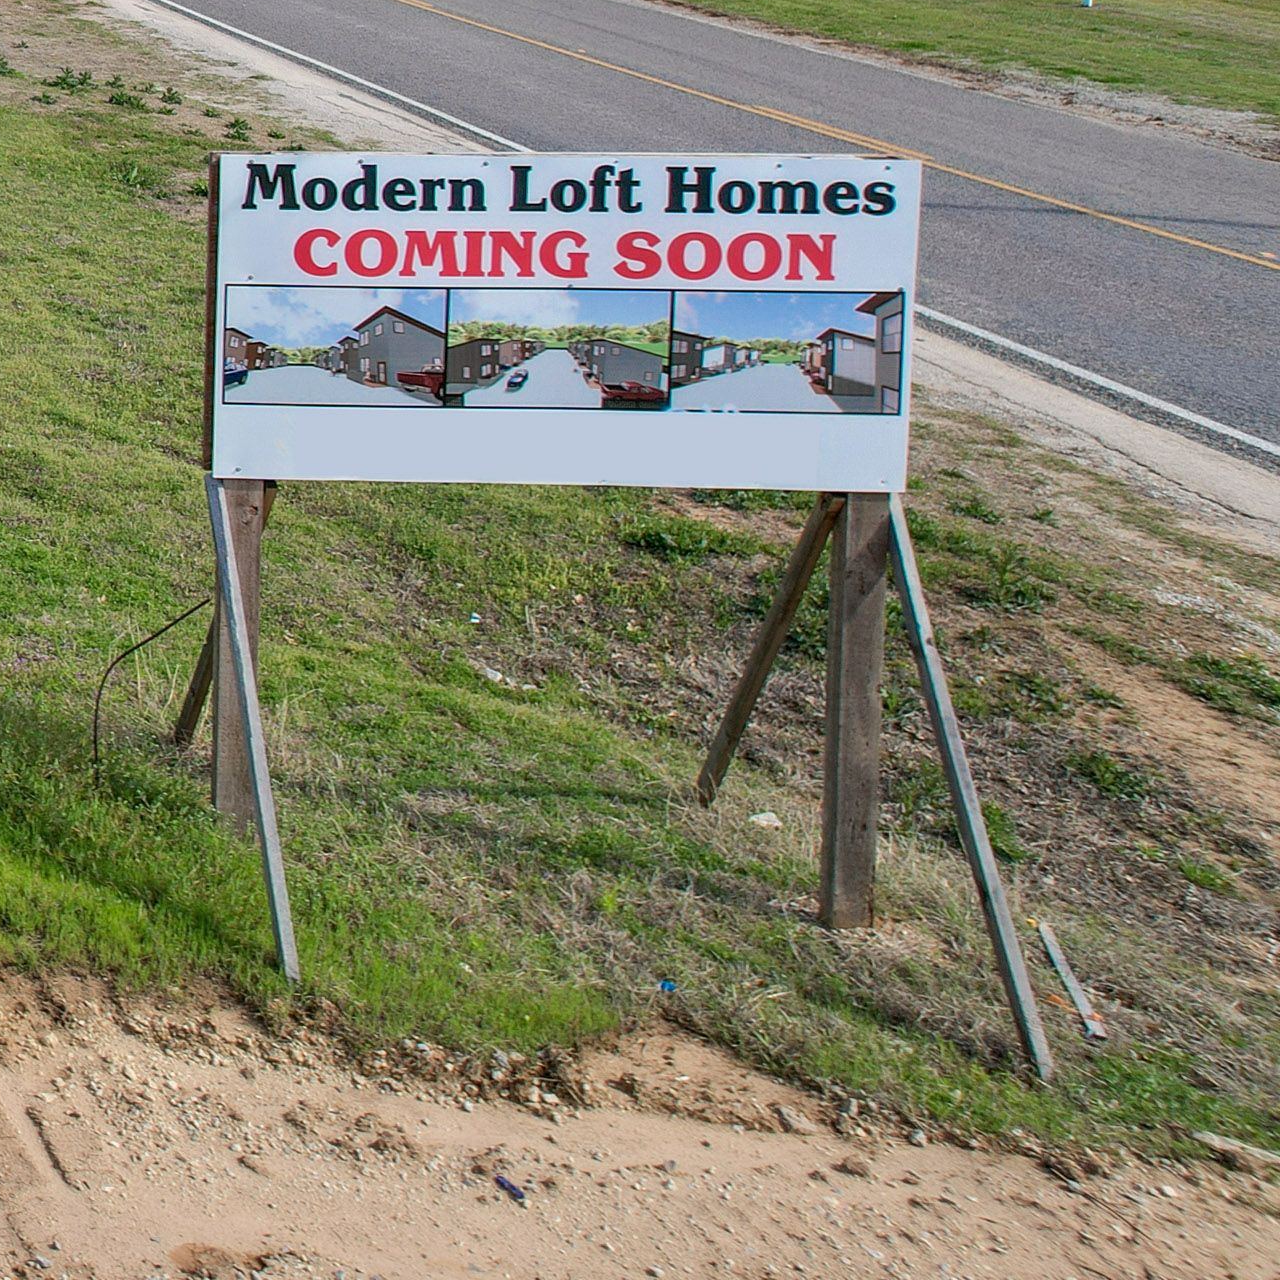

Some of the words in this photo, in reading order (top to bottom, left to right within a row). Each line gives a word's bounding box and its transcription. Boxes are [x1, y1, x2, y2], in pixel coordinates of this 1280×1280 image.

[242, 162, 487, 213] Modern
[509, 164, 643, 214] Loft
[665, 166, 897, 216] Homes
[293, 228, 590, 279] COMING
[614, 232, 837, 282] SOON
